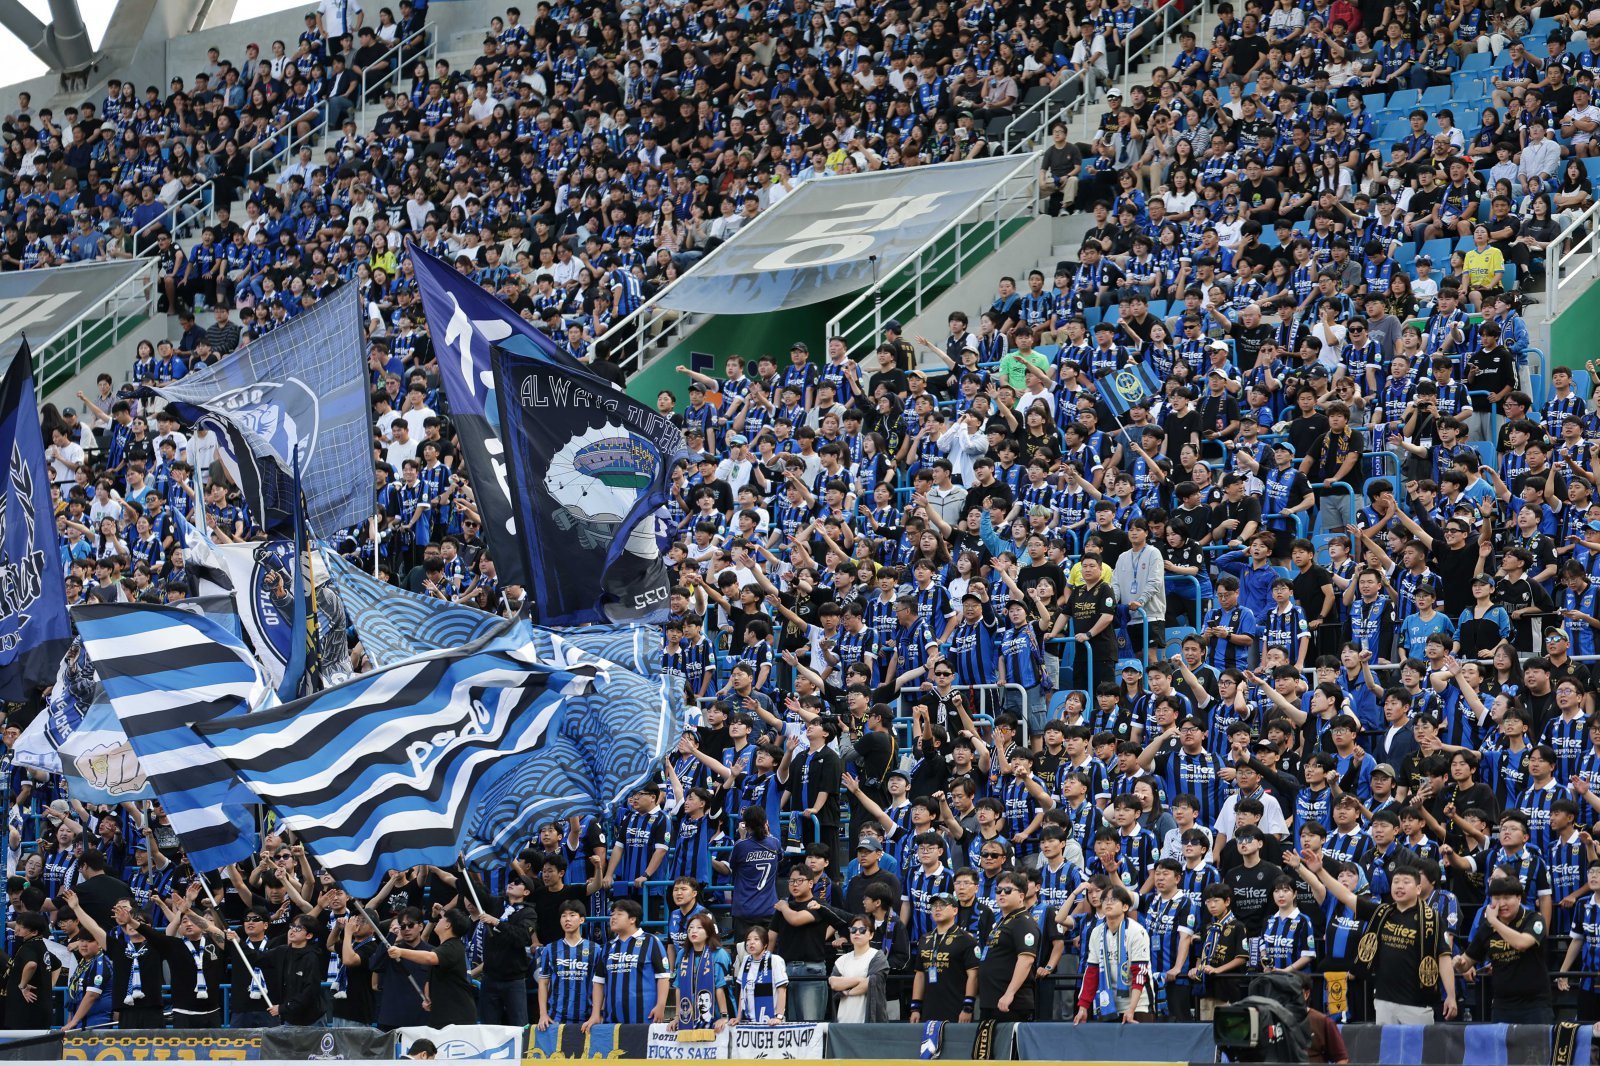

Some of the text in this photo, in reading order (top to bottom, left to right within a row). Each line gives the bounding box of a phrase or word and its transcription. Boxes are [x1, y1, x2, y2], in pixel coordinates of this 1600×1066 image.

[1273, 482, 1287, 491] ifez
[1066, 508, 1081, 516] ifez
[1000, 594, 1009, 602] ife
[881, 616, 897, 624] ifez
[1361, 619, 1377, 627] ifez
[961, 634, 976, 643] ifez
[1276, 630, 1291, 639] ifez
[406, 699, 491, 777] pado
[1563, 737, 1582, 747] ifez
[1193, 764, 1214, 774] ifez
[1509, 768, 1524, 779] ifez
[682, 776, 693, 784] ez
[1590, 771, 1600, 782] ife
[1531, 808, 1550, 818] ifez
[1074, 823, 1086, 831] ez
[636, 828, 650, 838] ifez
[1332, 850, 1352, 862] ifez
[53, 864, 66, 873] ifez
[1562, 863, 1579, 874] ifez
[755, 863, 772, 890] 7
[135, 887, 149, 898] ifez
[920, 889, 930, 902] ife
[1050, 889, 1067, 898] ifez
[1246, 887, 1266, 898] ifez
[1162, 915, 1174, 923] ez
[1343, 917, 1360, 927] ifez
[677, 931, 687, 939] ife
[1396, 924, 1416, 938] ifez
[1274, 936, 1293, 947] ifez
[618, 952, 637, 962] ifez
[930, 950, 949, 960] iez
[570, 958, 588, 970] ifez
[979, 1029, 987, 1059] NITED
[687, 1047, 717, 1059] SAKE
